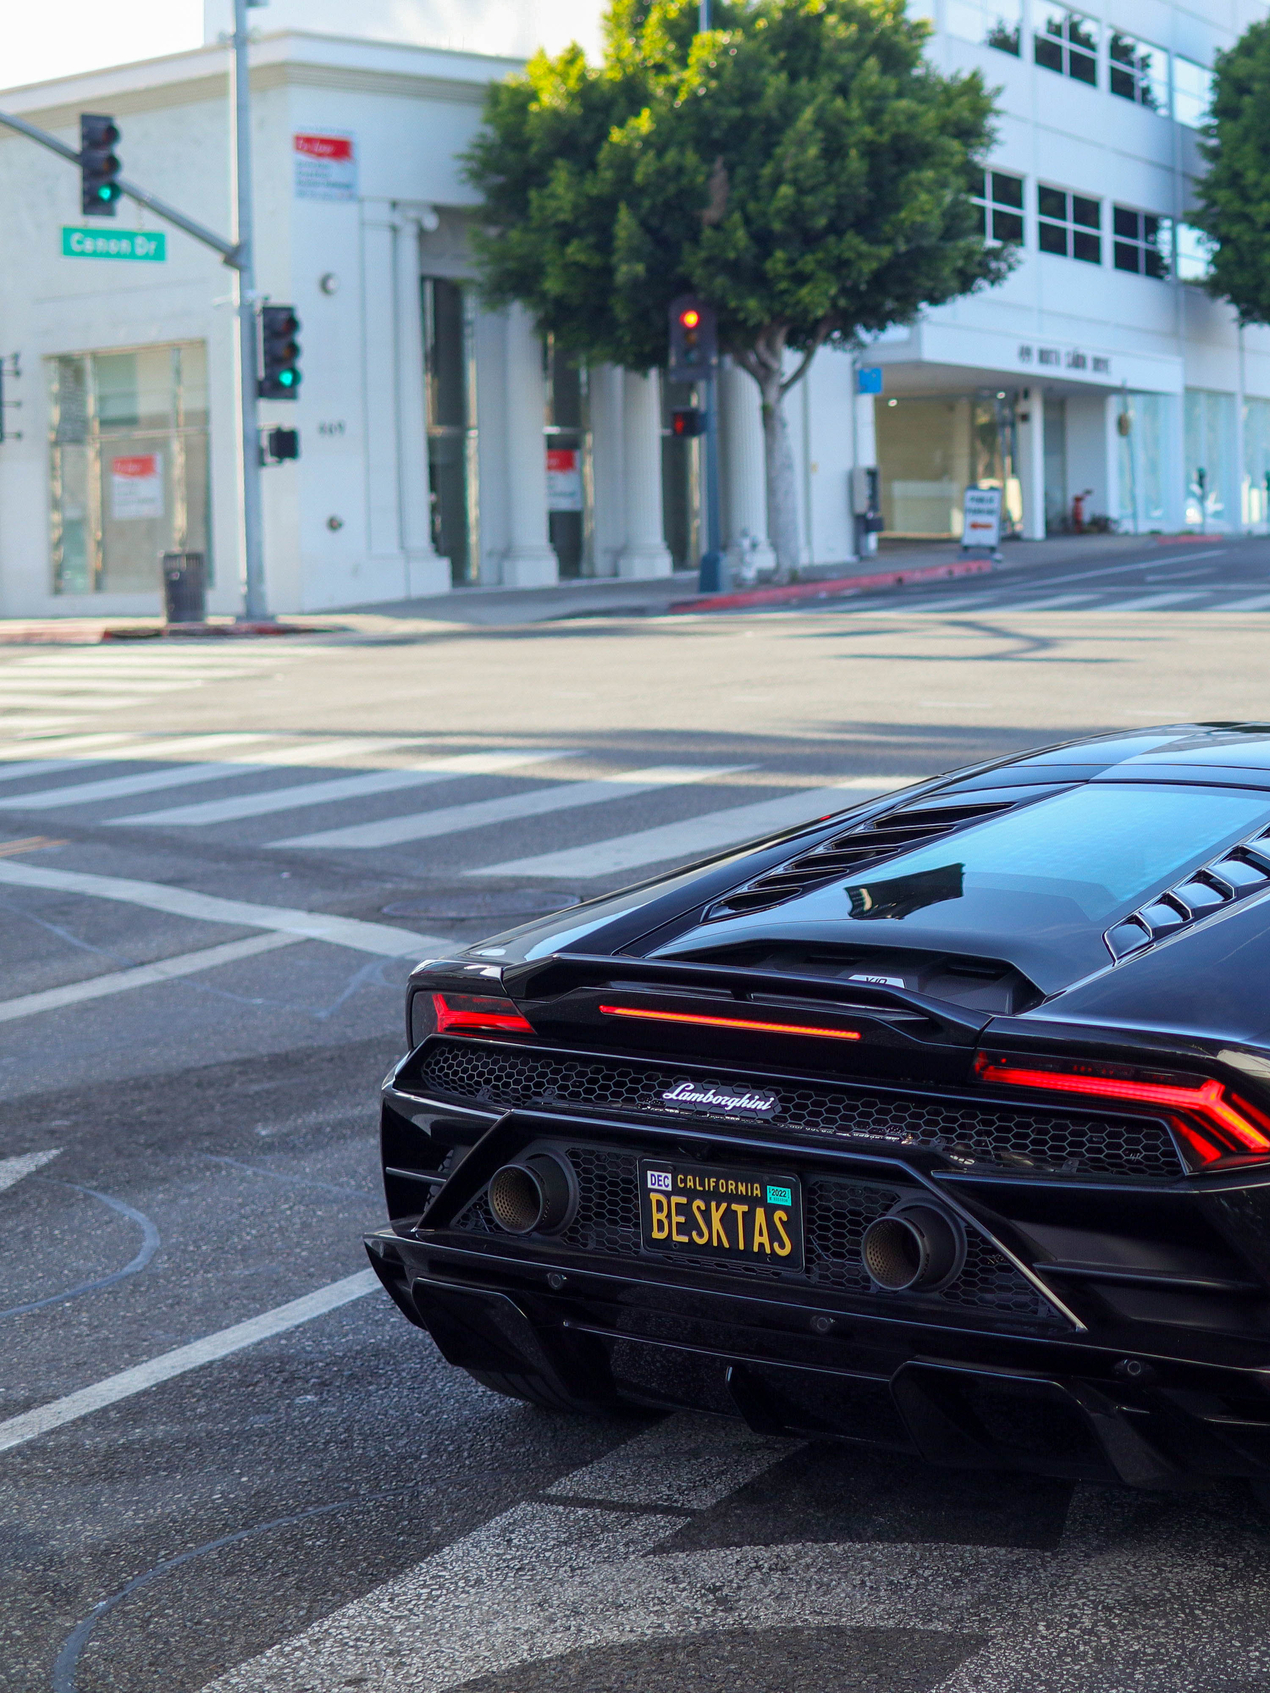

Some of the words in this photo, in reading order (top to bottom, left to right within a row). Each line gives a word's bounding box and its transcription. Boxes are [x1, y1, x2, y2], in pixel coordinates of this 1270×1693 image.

[69, 232, 132, 255] Canon
[134, 235, 158, 257] Dr
[662, 1082, 775, 1111] Lamborghini
[650, 1173, 670, 1188] DEC
[677, 1174, 761, 1198] CALIFORNIA
[771, 1188, 787, 1198] 2022
[649, 1192, 792, 1257] BESKTAS
